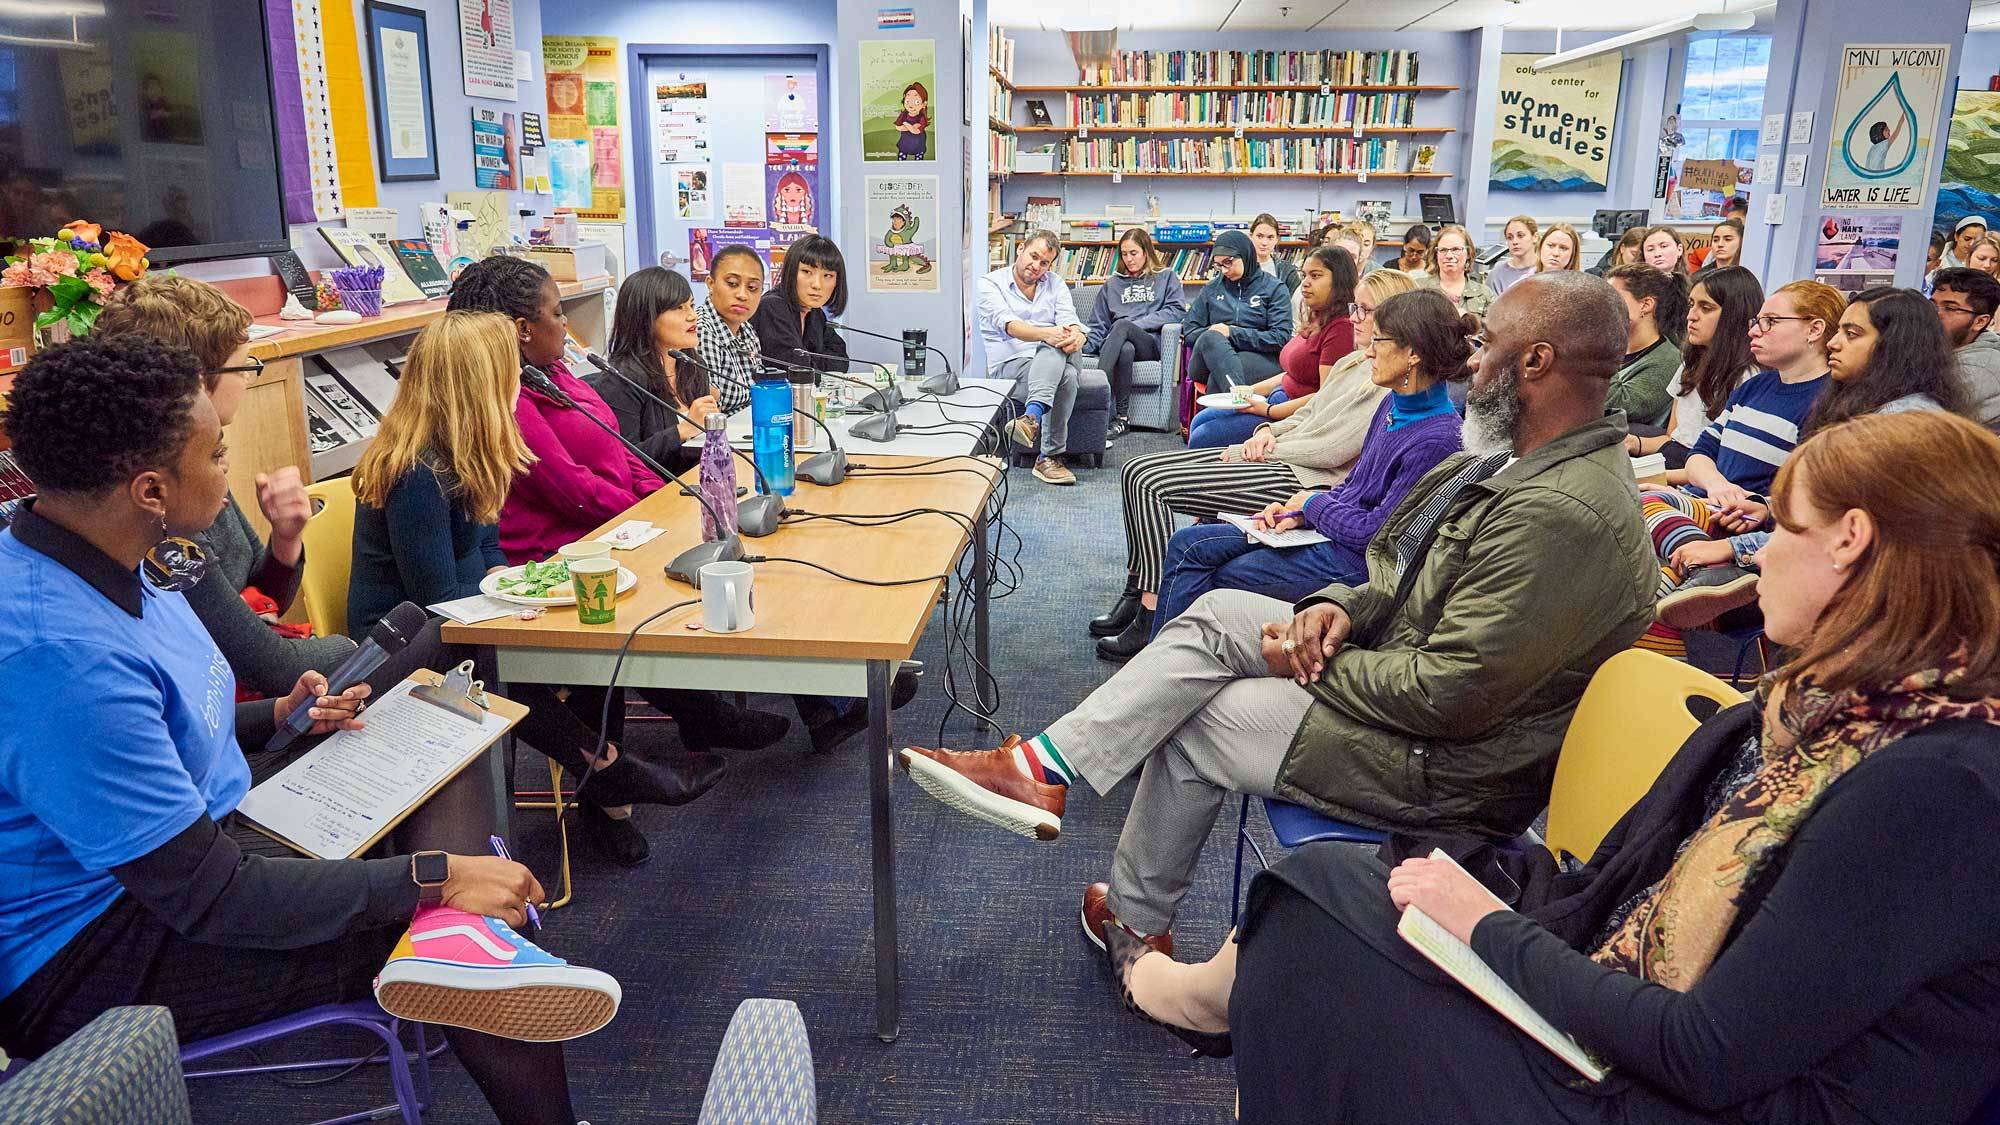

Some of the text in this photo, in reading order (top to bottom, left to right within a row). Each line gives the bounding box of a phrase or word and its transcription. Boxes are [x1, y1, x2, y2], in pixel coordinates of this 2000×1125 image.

[1848, 50, 1941, 67] MNI WICONI
[1551, 78, 1584, 86] center
[1585, 89, 1599, 98] for
[481, 109, 495, 121] STOP
[1501, 90, 1607, 140] women's
[476, 134, 485, 144] THE
[485, 134, 497, 145] WAR
[1504, 111, 1604, 161] studies
[480, 156, 500, 168] WOMEN
[1827, 187, 1911, 202] WATER IS LIFE
